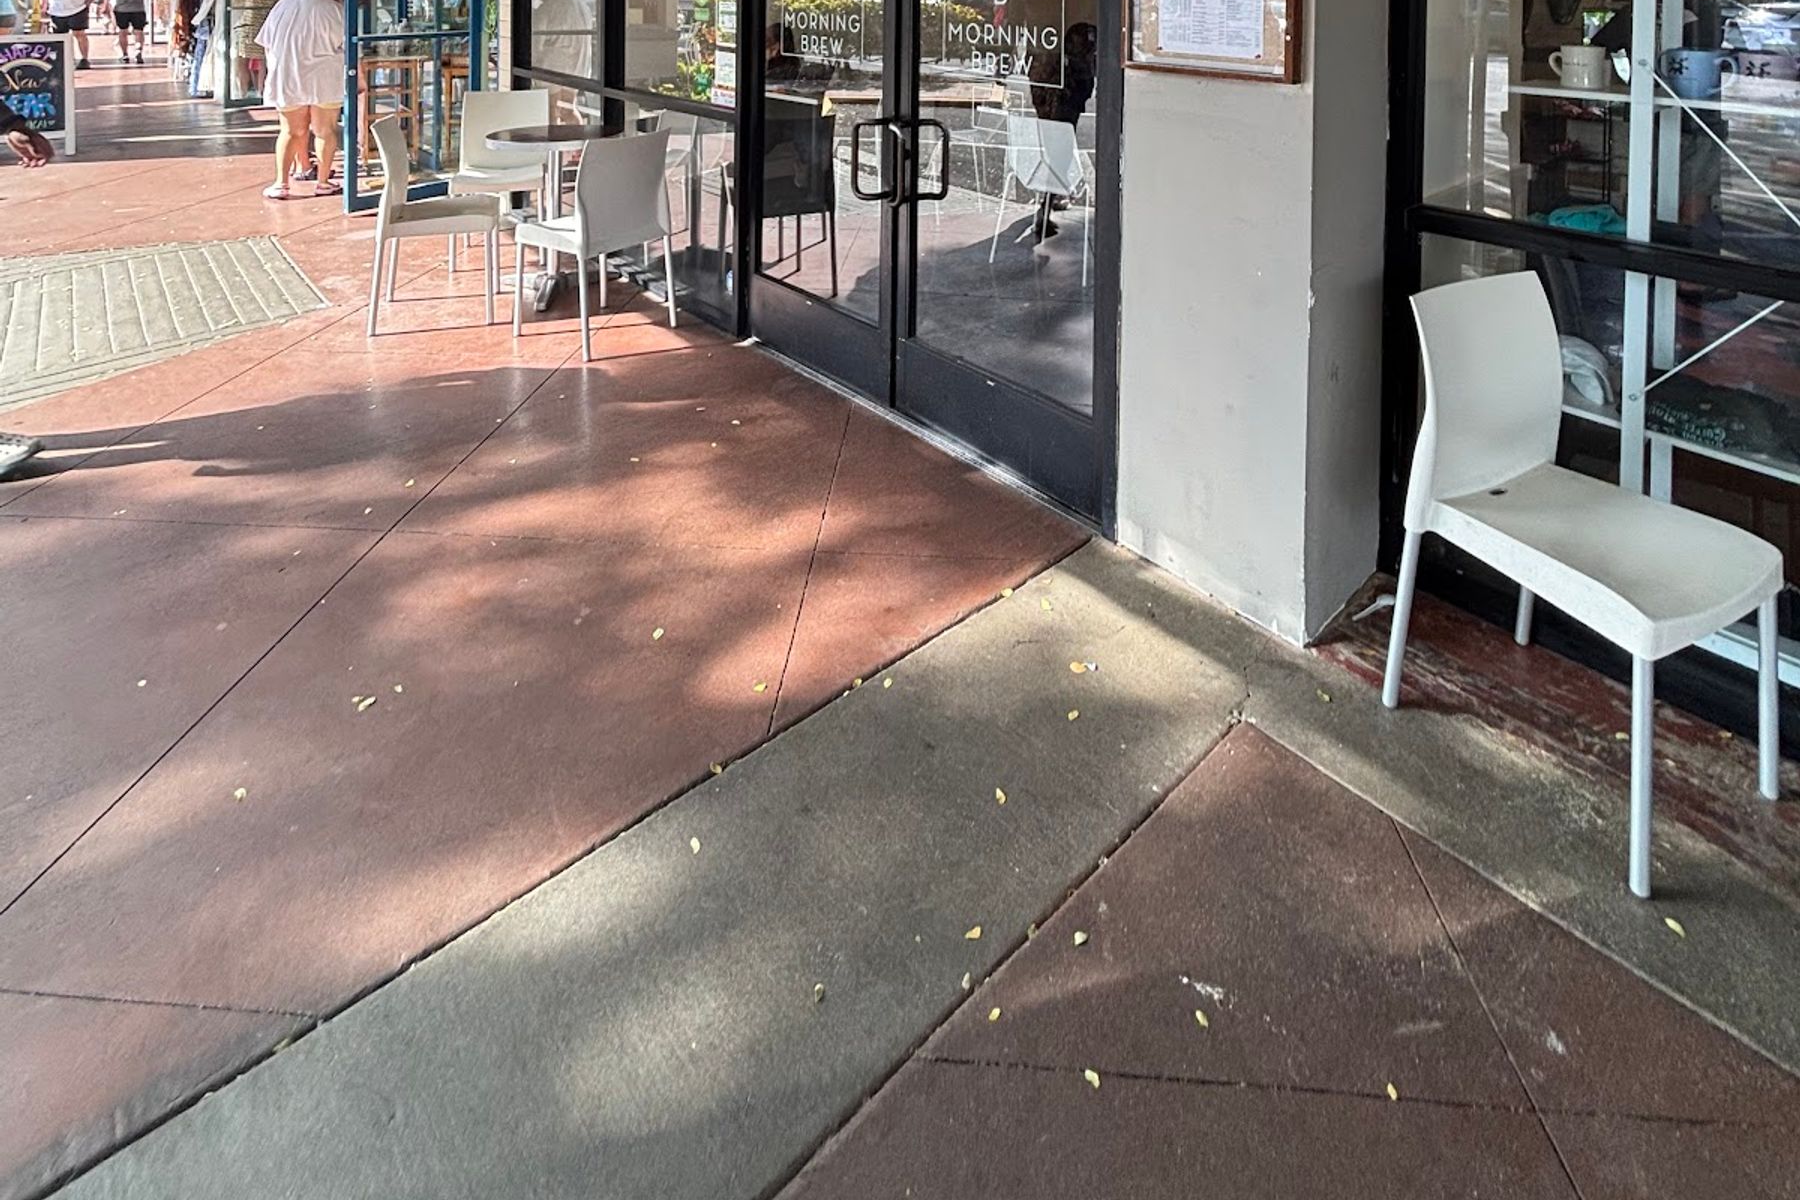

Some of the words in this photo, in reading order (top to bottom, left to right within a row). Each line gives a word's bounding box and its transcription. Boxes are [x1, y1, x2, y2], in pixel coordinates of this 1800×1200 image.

[784, 11, 861, 33] MORNING
[801, 34, 844, 57] BREW
[948, 22, 1059, 50] MORNING
[971, 51, 1034, 76] BREW
[3, 93, 56, 118] EAR
